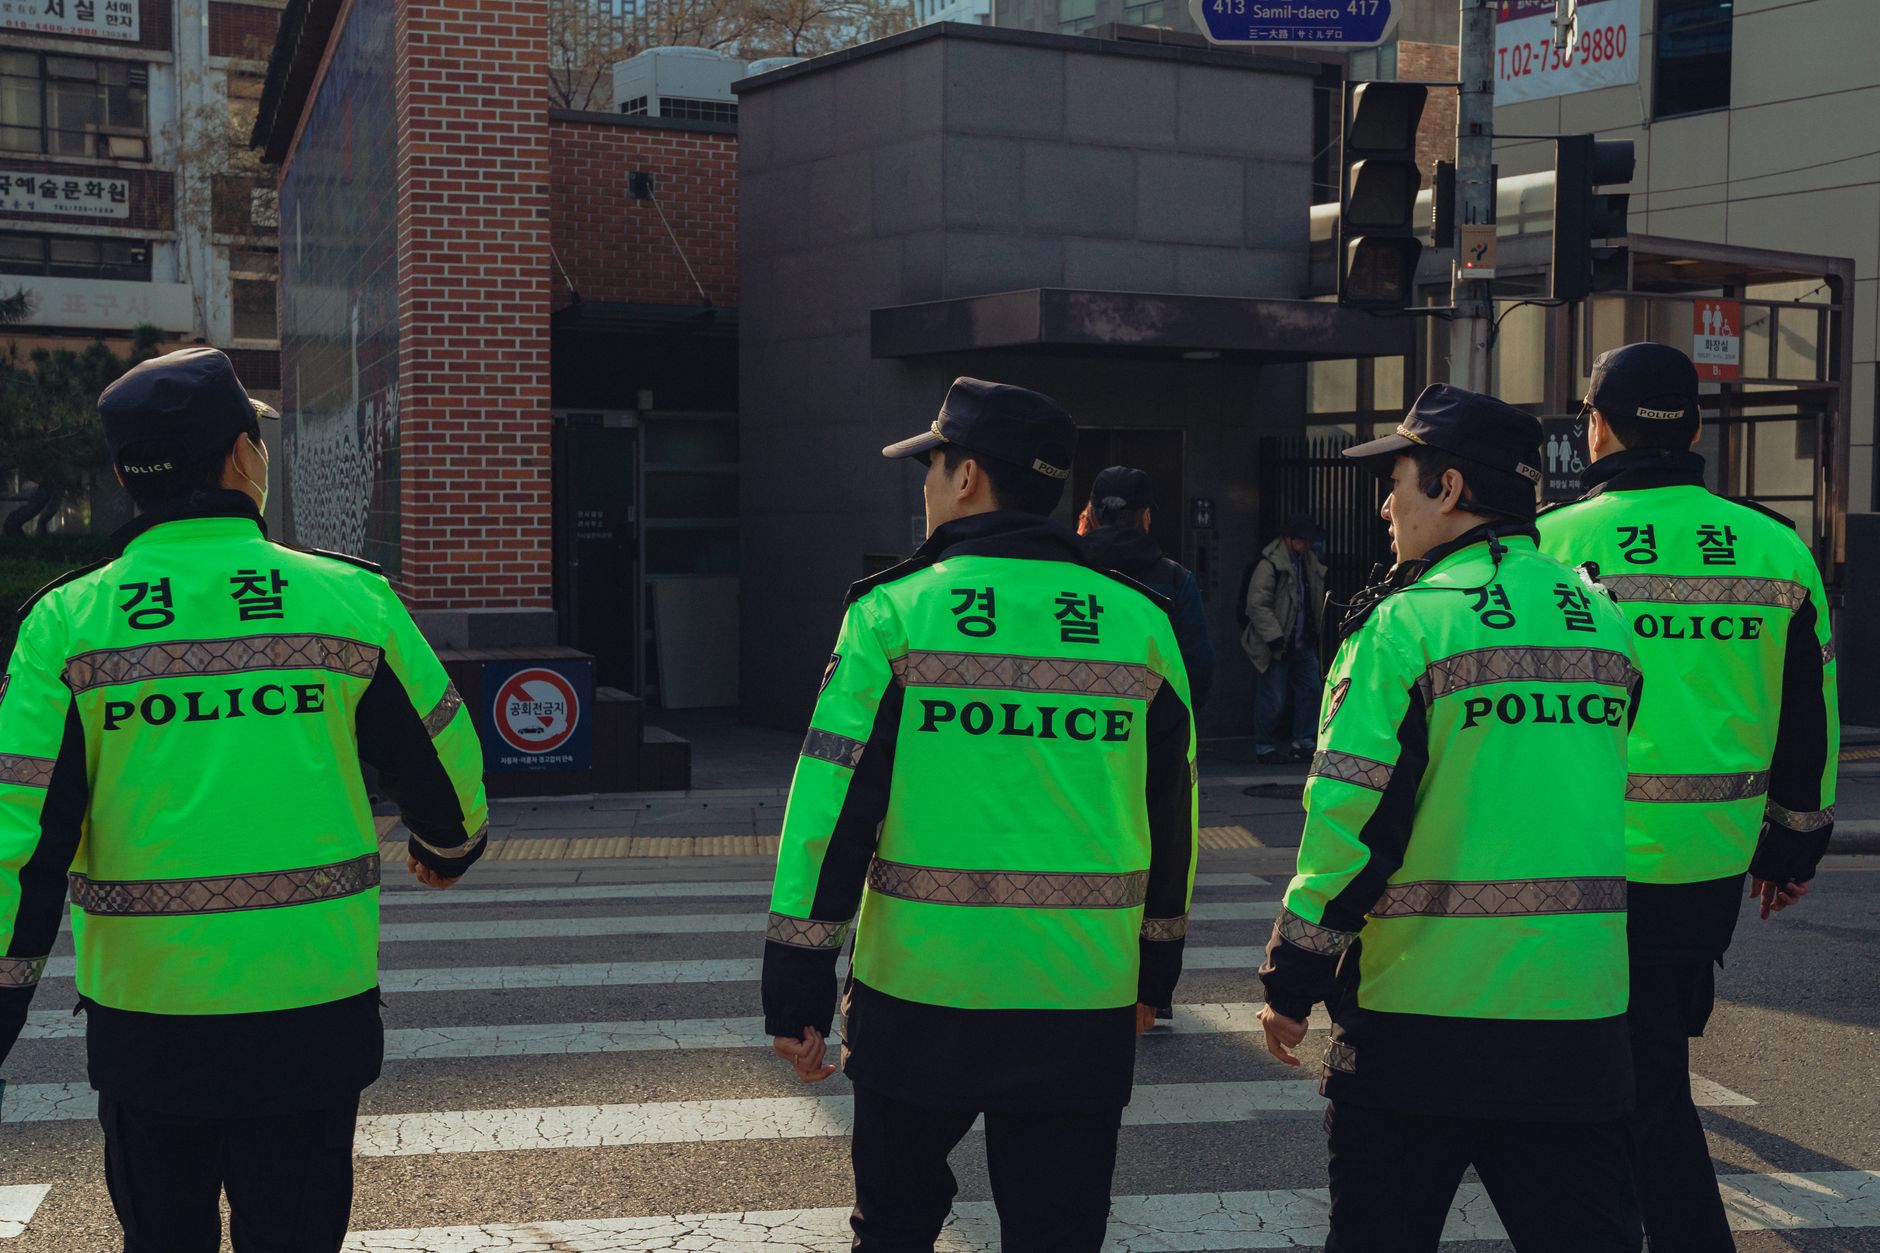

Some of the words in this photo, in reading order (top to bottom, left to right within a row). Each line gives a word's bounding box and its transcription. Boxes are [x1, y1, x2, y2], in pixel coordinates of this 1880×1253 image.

[1213, 0, 1245, 14] 413
[1253, 4, 1340, 19] Samil-daero
[1347, 1, 1379, 16] 417
[1248, 29, 1289, 39] 三一大路
[1297, 29, 1343, 39] サミルデロ
[1705, 339, 1729, 352] 화장실
[1640, 409, 1681, 419] POLICE
[124, 462, 173, 474] POLICE
[1633, 613, 1764, 640] OLICE
[103, 683, 325, 731] POLICE
[510, 701, 565, 717] 공회전금지
[1460, 692, 1627, 730] POLICE
[917, 699, 1134, 742] POLICE
